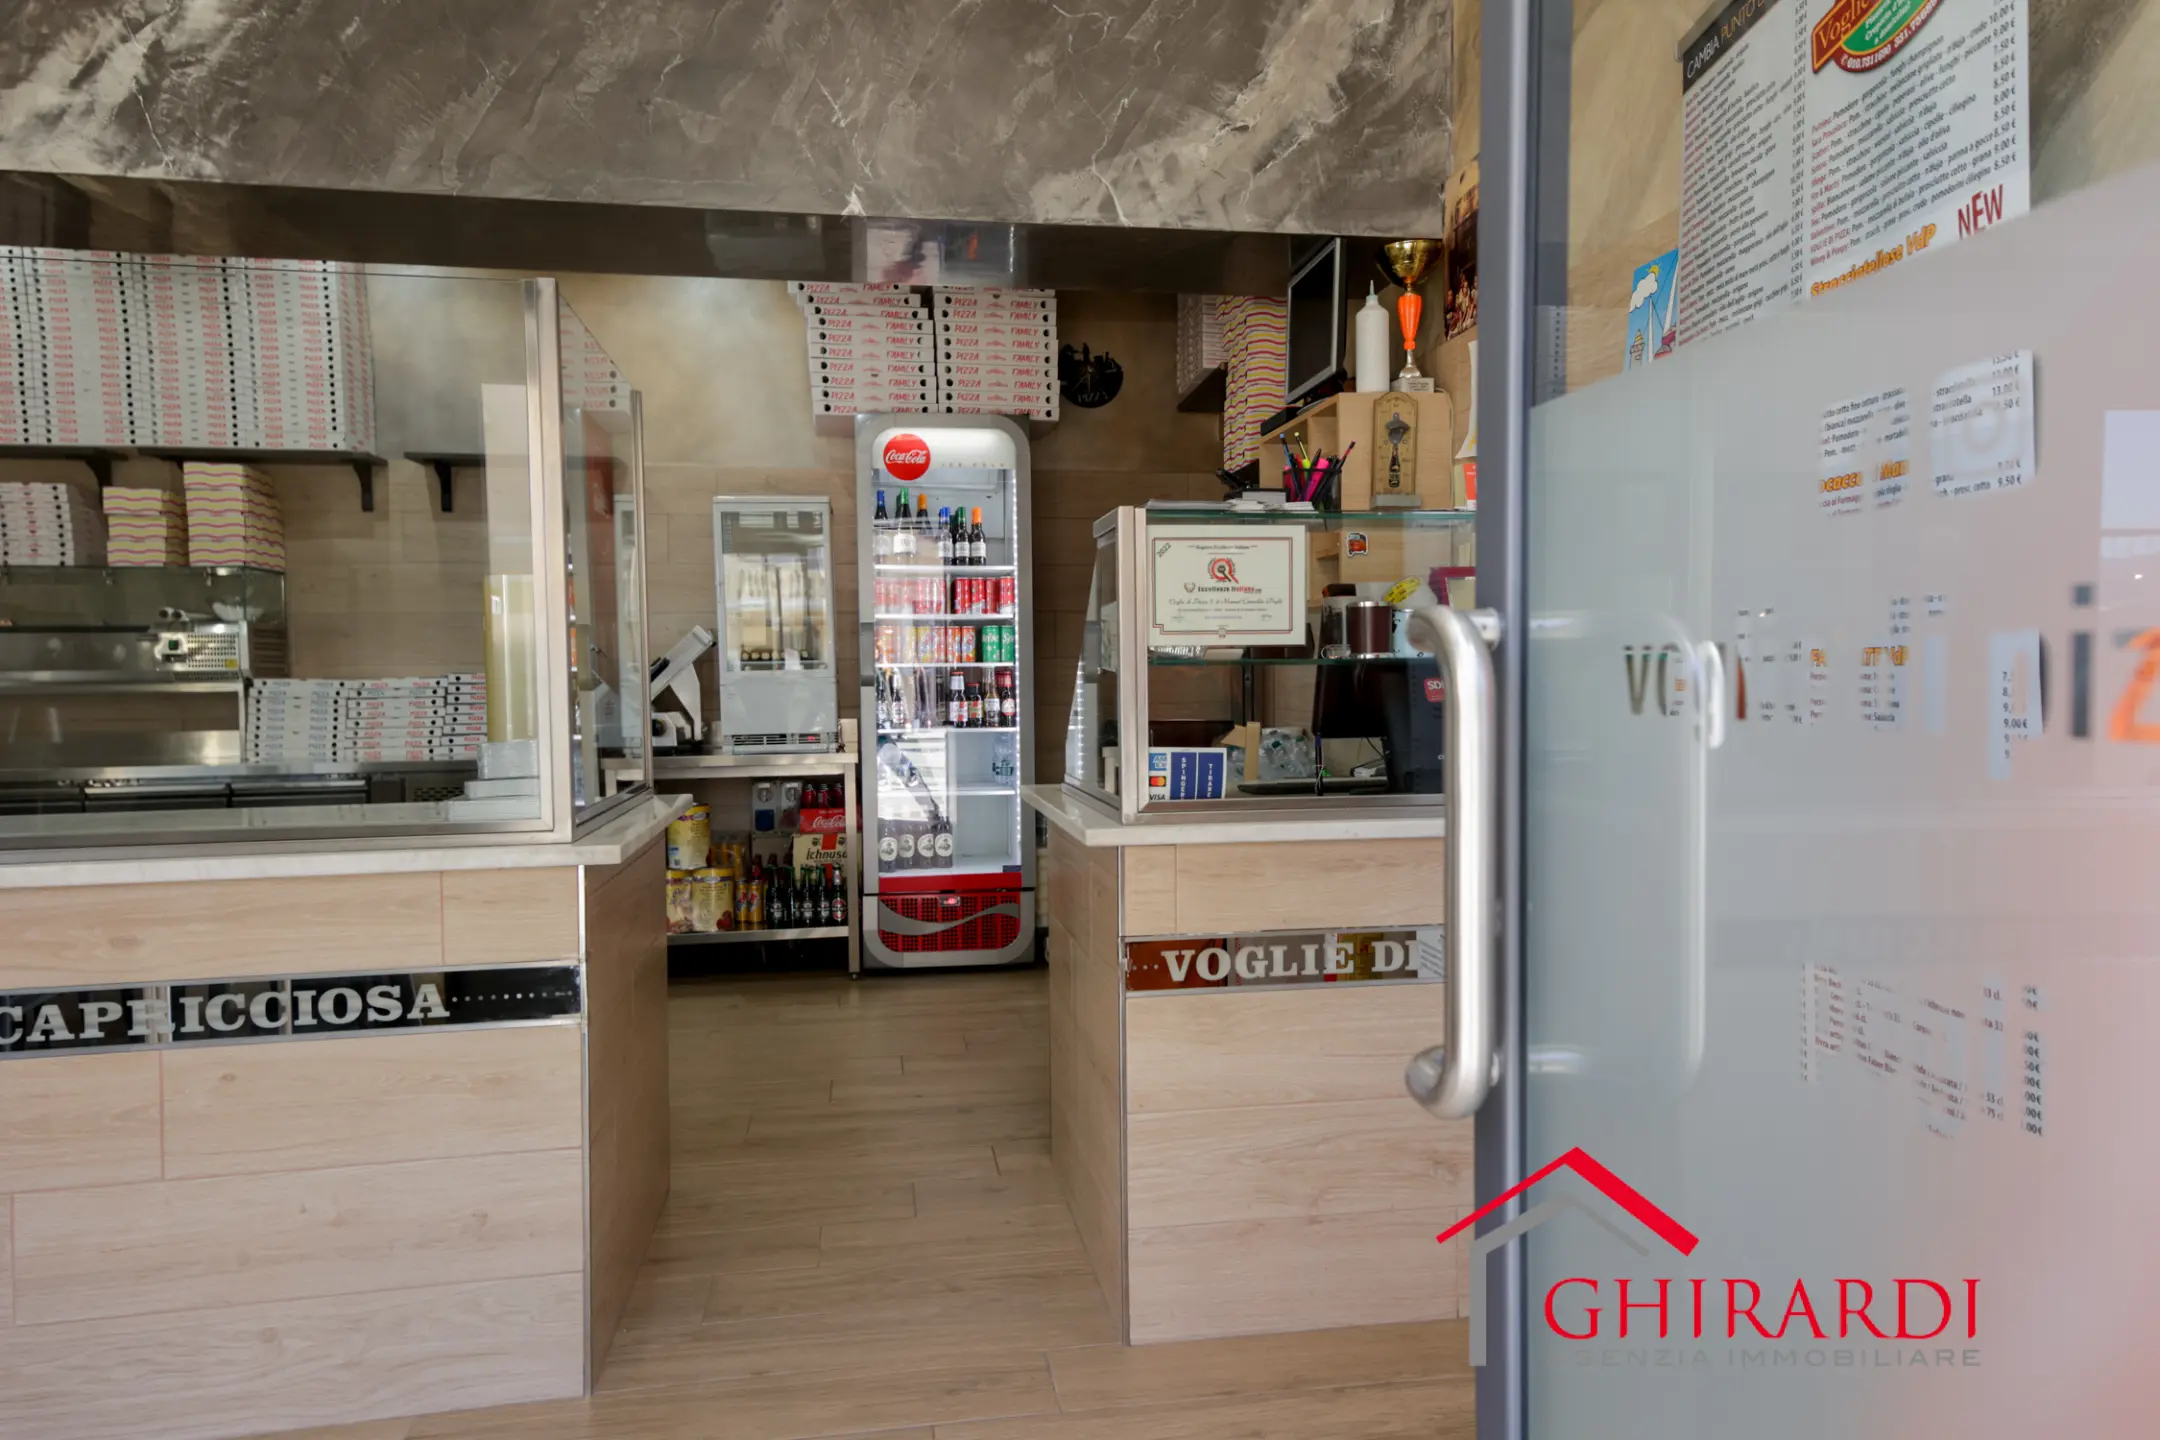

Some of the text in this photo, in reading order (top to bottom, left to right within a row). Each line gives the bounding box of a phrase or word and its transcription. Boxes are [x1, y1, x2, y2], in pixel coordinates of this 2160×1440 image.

[1687, 35, 1720, 79] CAMBIA
[1906, 223, 1937, 257] VdP
[1958, 184, 2004, 239] NEW
[808, 284, 831, 292] PIZZA
[952, 310, 976, 318] PIZZA
[828, 320, 852, 328] PIZZA
[829, 334, 852, 342] PIZZA
[956, 338, 979, 346] PIZZA
[829, 348, 853, 356] PIZZA
[957, 352, 979, 360] PIZZA
[956, 366, 979, 374] PIZZA
[832, 378, 855, 386] PIZZA
[832, 392, 855, 400] PIZZA
[886, 449, 928, 464] Coca-Cola
[1157, 543, 1171, 557] 2022
[1161, 942, 1354, 982] VOGLIE
[0, 983, 450, 1046] CAPRICCIOSA
